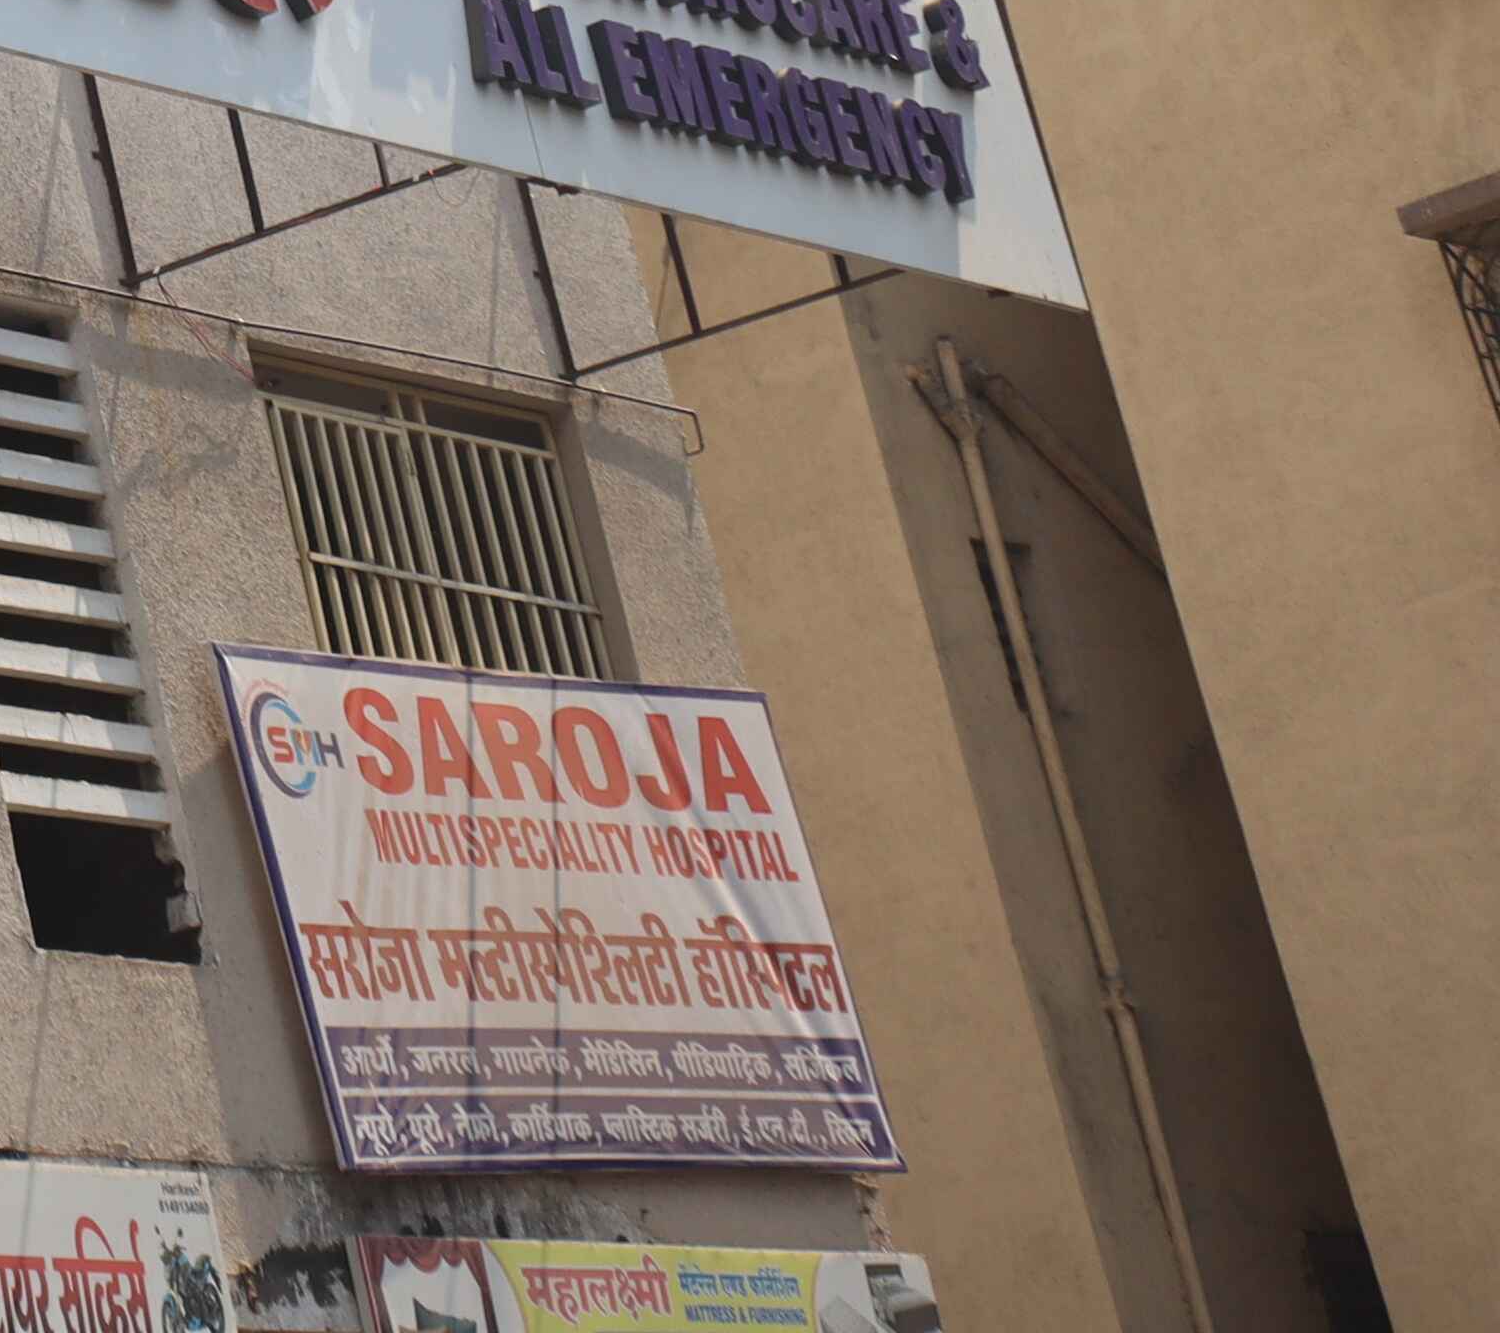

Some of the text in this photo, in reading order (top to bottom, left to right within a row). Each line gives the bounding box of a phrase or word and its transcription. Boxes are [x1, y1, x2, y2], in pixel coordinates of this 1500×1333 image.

[586, 18, 976, 205] EMERGENCY
[267, 726, 346, 769] SMH
[342, 686, 774, 816] SAROJA
[364, 808, 799, 883] MULTISPECIALITY HOSPITAL
[299, 900, 437, 1003] सरोजा
[684, 915, 850, 1014] हॉस्पिटल
[520, 1254, 673, 1326] महालक्ष्मी
